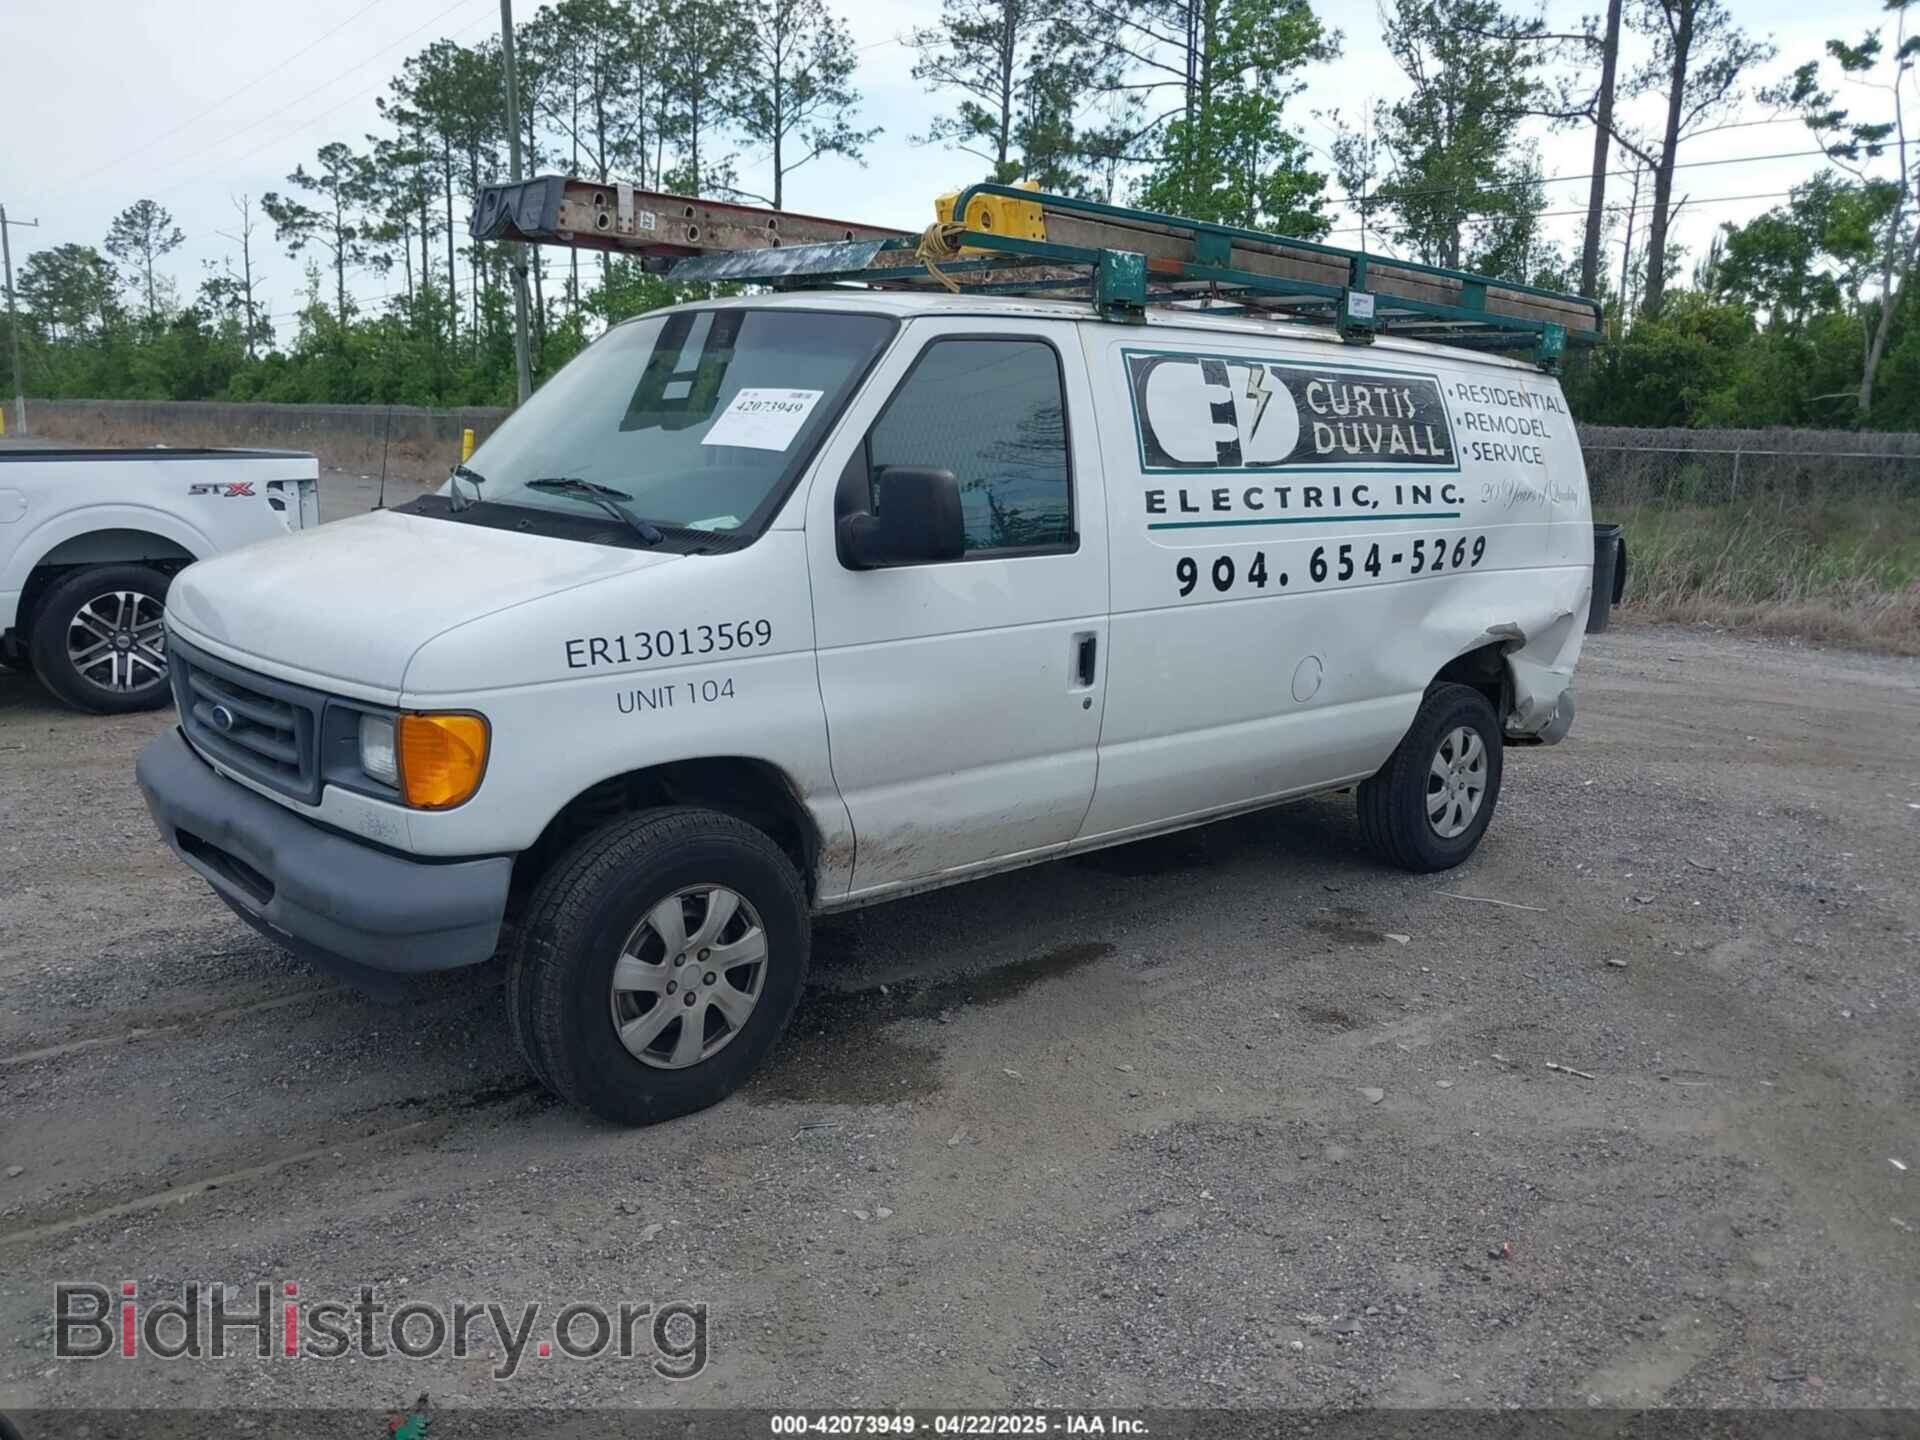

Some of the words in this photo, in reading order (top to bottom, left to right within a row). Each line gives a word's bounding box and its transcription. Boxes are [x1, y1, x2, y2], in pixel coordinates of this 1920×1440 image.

[1306, 381, 1416, 419] CURTIS
[1456, 383, 1566, 415] RESIDENTIAL
[1313, 421, 1445, 456] DUVALL
[1464, 412, 1551, 438] REMODEL
[1472, 441, 1544, 465] SERVICE
[187, 481, 256, 498] STX
[1145, 485, 1379, 514] ELECTRIC,
[1395, 484, 1465, 505] INC.
[565, 619, 772, 668] ER13013569
[617, 685, 675, 714] UNIT
[687, 678, 736, 703] 104
